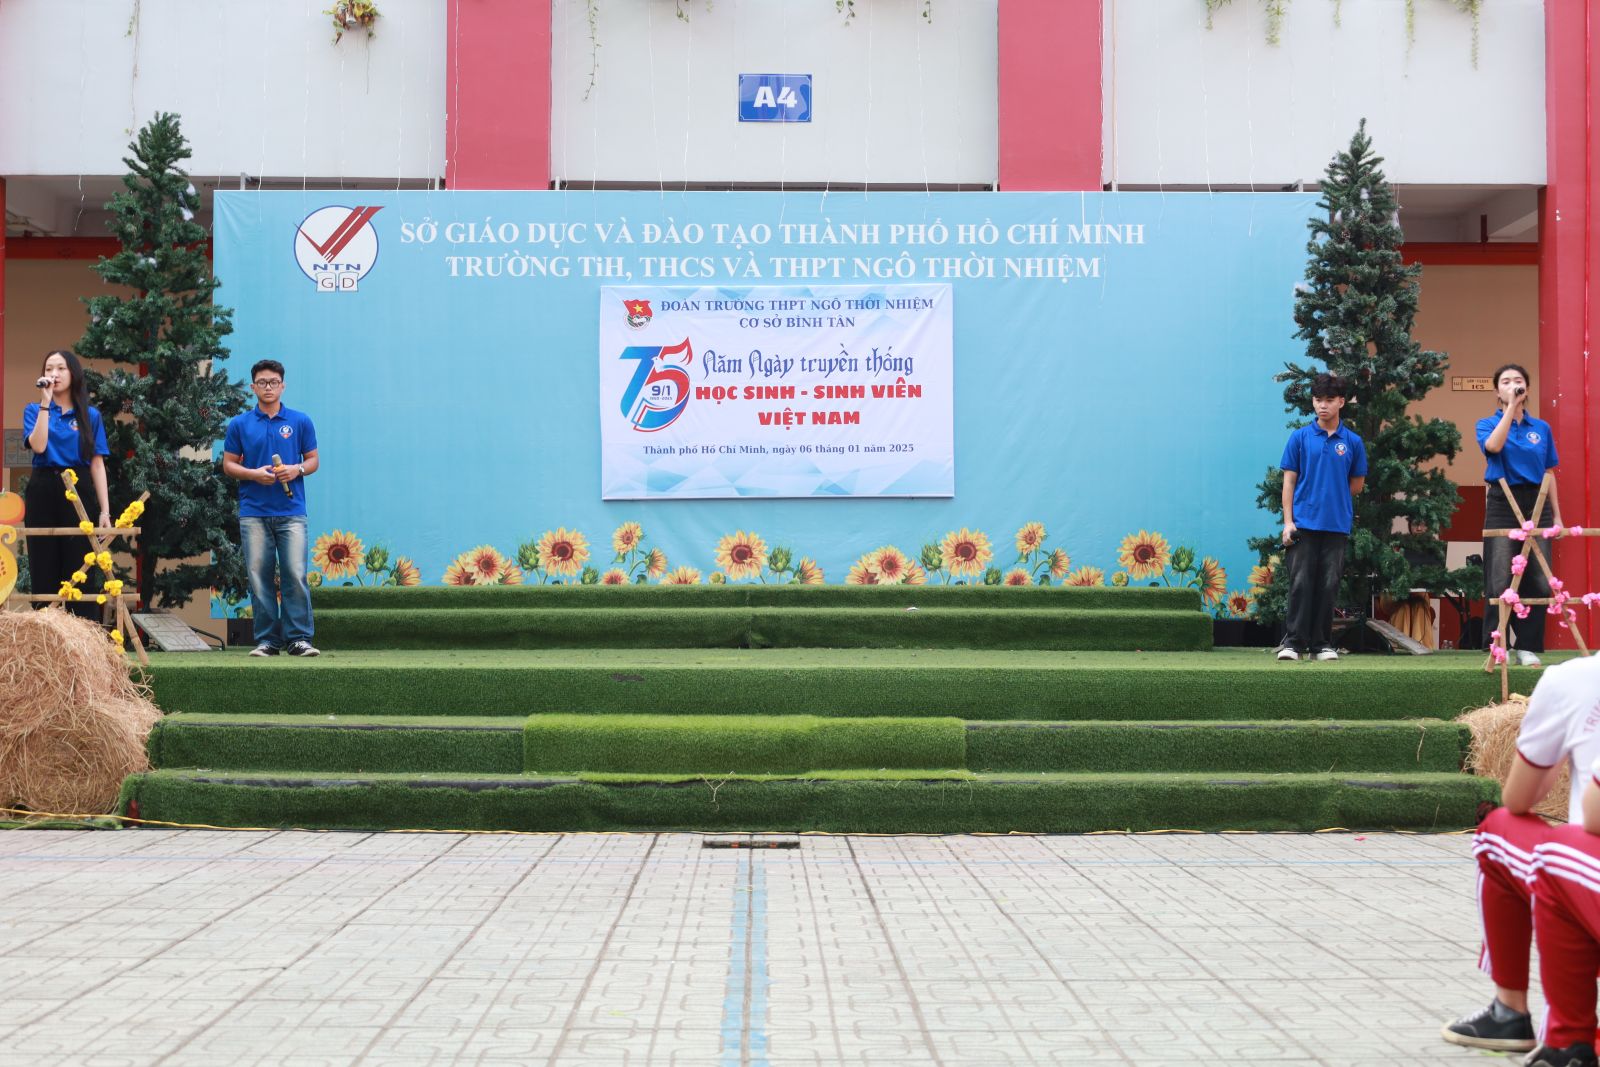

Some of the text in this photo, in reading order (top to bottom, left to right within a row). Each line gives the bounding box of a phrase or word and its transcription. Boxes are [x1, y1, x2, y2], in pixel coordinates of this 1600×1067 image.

[753, 86, 797, 108] A4
[400, 216, 1145, 249] SỞ GIÁO DỤC VÀ ĐÀO TẠO THÀNH PHỐ HỒ CHÍ MINH
[445, 250, 570, 277] TRƯỜNG
[640, 257, 715, 278] THCS
[723, 251, 762, 278] VÀ
[770, 257, 845, 278] THPT
[853, 251, 916, 278] NGÔ
[923, 251, 995, 278] THỜI
[1003, 254, 1100, 283] NHIỆM
[661, 297, 933, 312] ĐOÀN TRƯỜNG THPT NGÔ THỜI NHIỆM
[739, 313, 855, 328] CƠ SỞ BÌNH TÂN
[703, 343, 914, 379] Năm Ngày truyền thống
[652, 385, 671, 396] 9/1
[695, 386, 738, 404] HỌC
[743, 386, 795, 399] SINH
[814, 385, 865, 399] SINH
[871, 377, 922, 398] VIÊN
[758, 407, 860, 430] VIỆT NAM
[739, 444, 769, 455] Minh,
[772, 445, 796, 456] ngày
[799, 445, 812, 453] 06
[815, 444, 845, 455] tháng
[848, 445, 860, 453] 01
[889, 444, 914, 453] 2025
